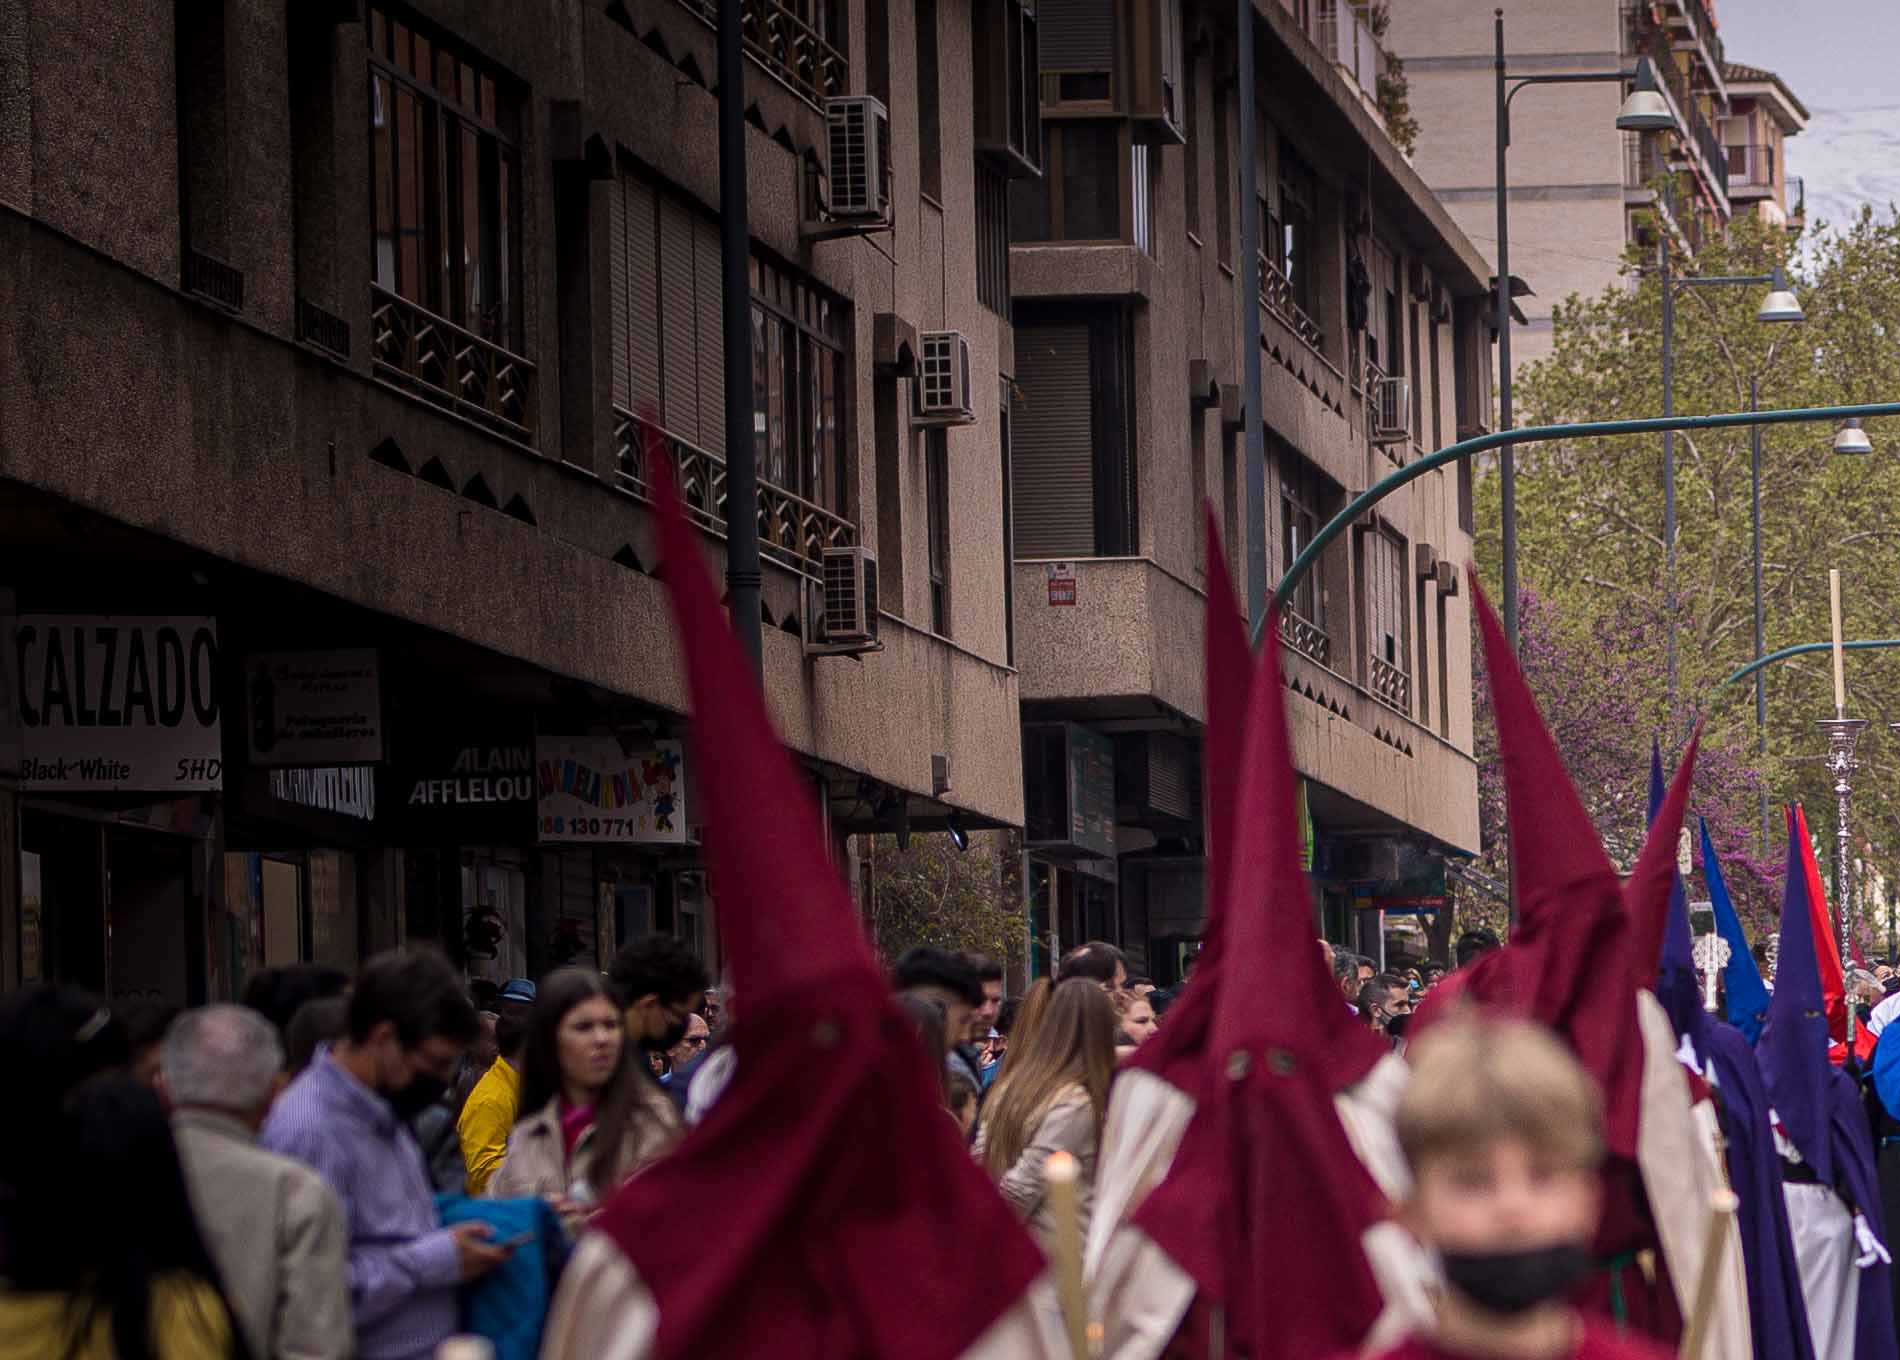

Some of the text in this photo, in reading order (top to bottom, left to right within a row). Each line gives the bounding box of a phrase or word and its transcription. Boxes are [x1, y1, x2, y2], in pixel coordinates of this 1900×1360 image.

[16, 626, 217, 727] CALZADO
[451, 746, 531, 773] ALAIN
[407, 776, 532, 806] AFFLELOU
